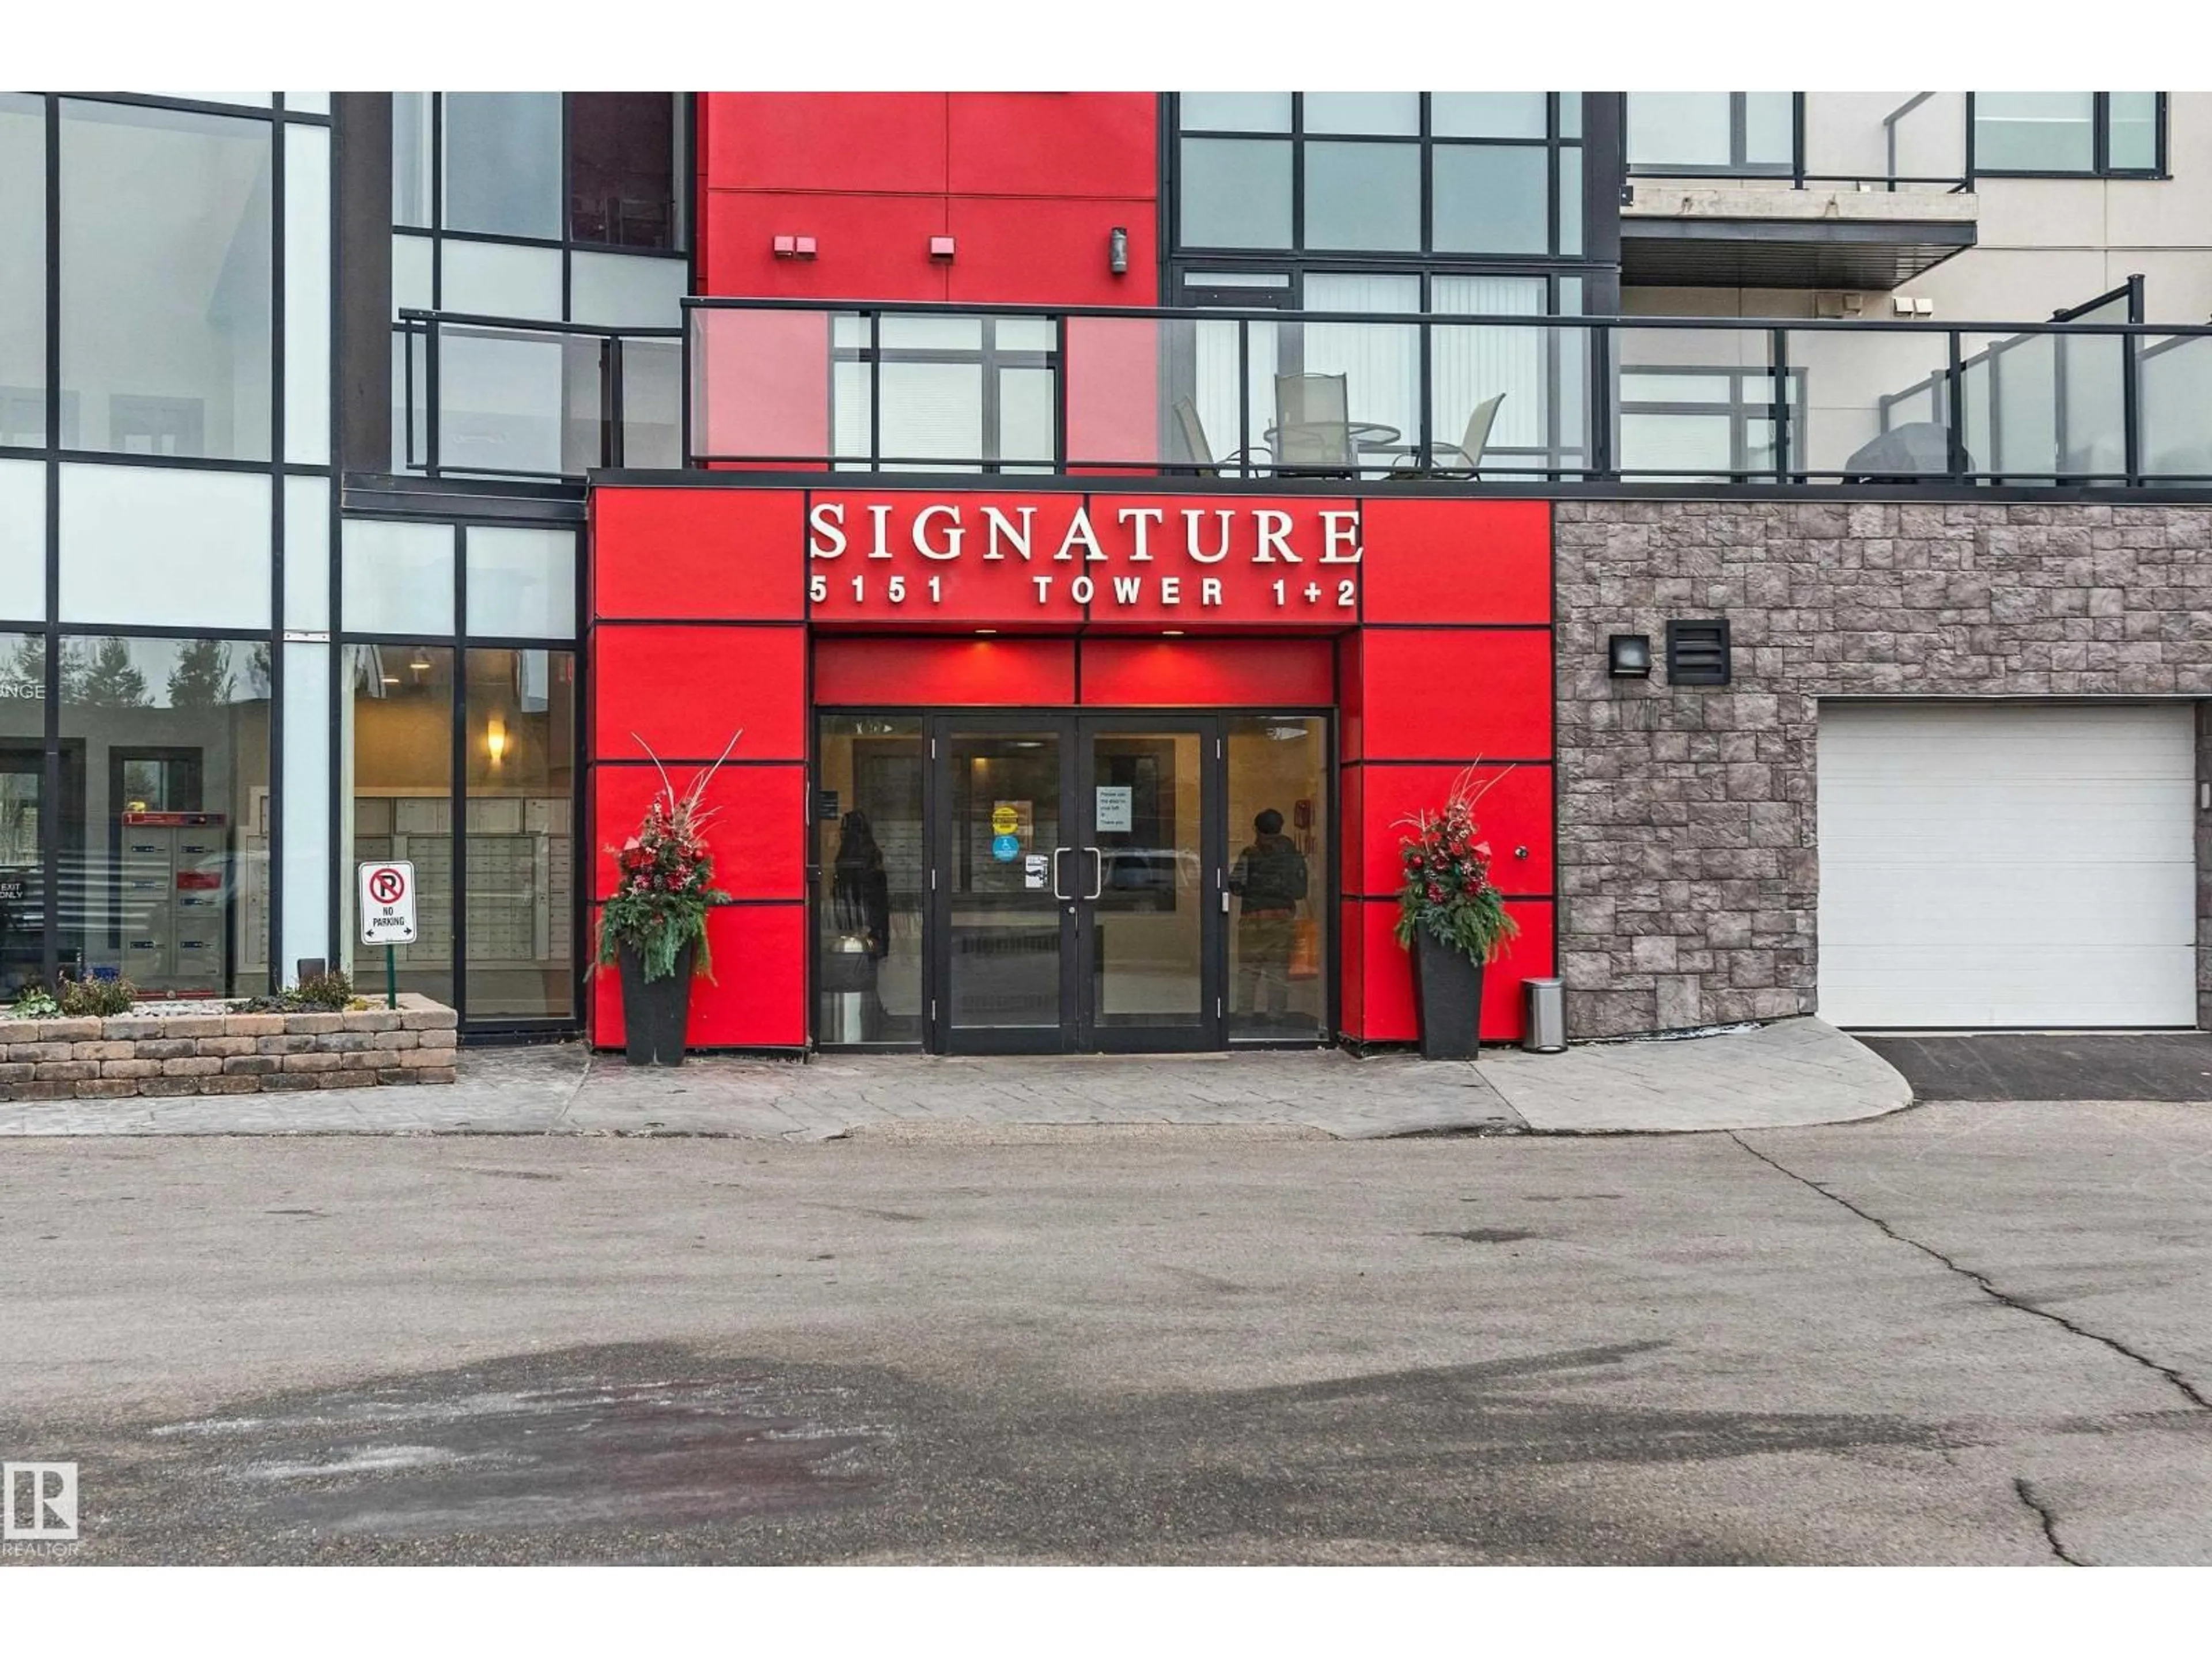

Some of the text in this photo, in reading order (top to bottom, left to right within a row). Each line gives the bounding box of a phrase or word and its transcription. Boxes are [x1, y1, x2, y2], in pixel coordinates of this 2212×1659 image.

[809, 504, 1365, 563] SIGNATURE
[809, 575, 1355, 606] 5151 TOWER 1+2
[1, 883, 21, 891] EXIT
[382, 907, 393, 916] NO
[373, 917, 405, 927] PARKING
